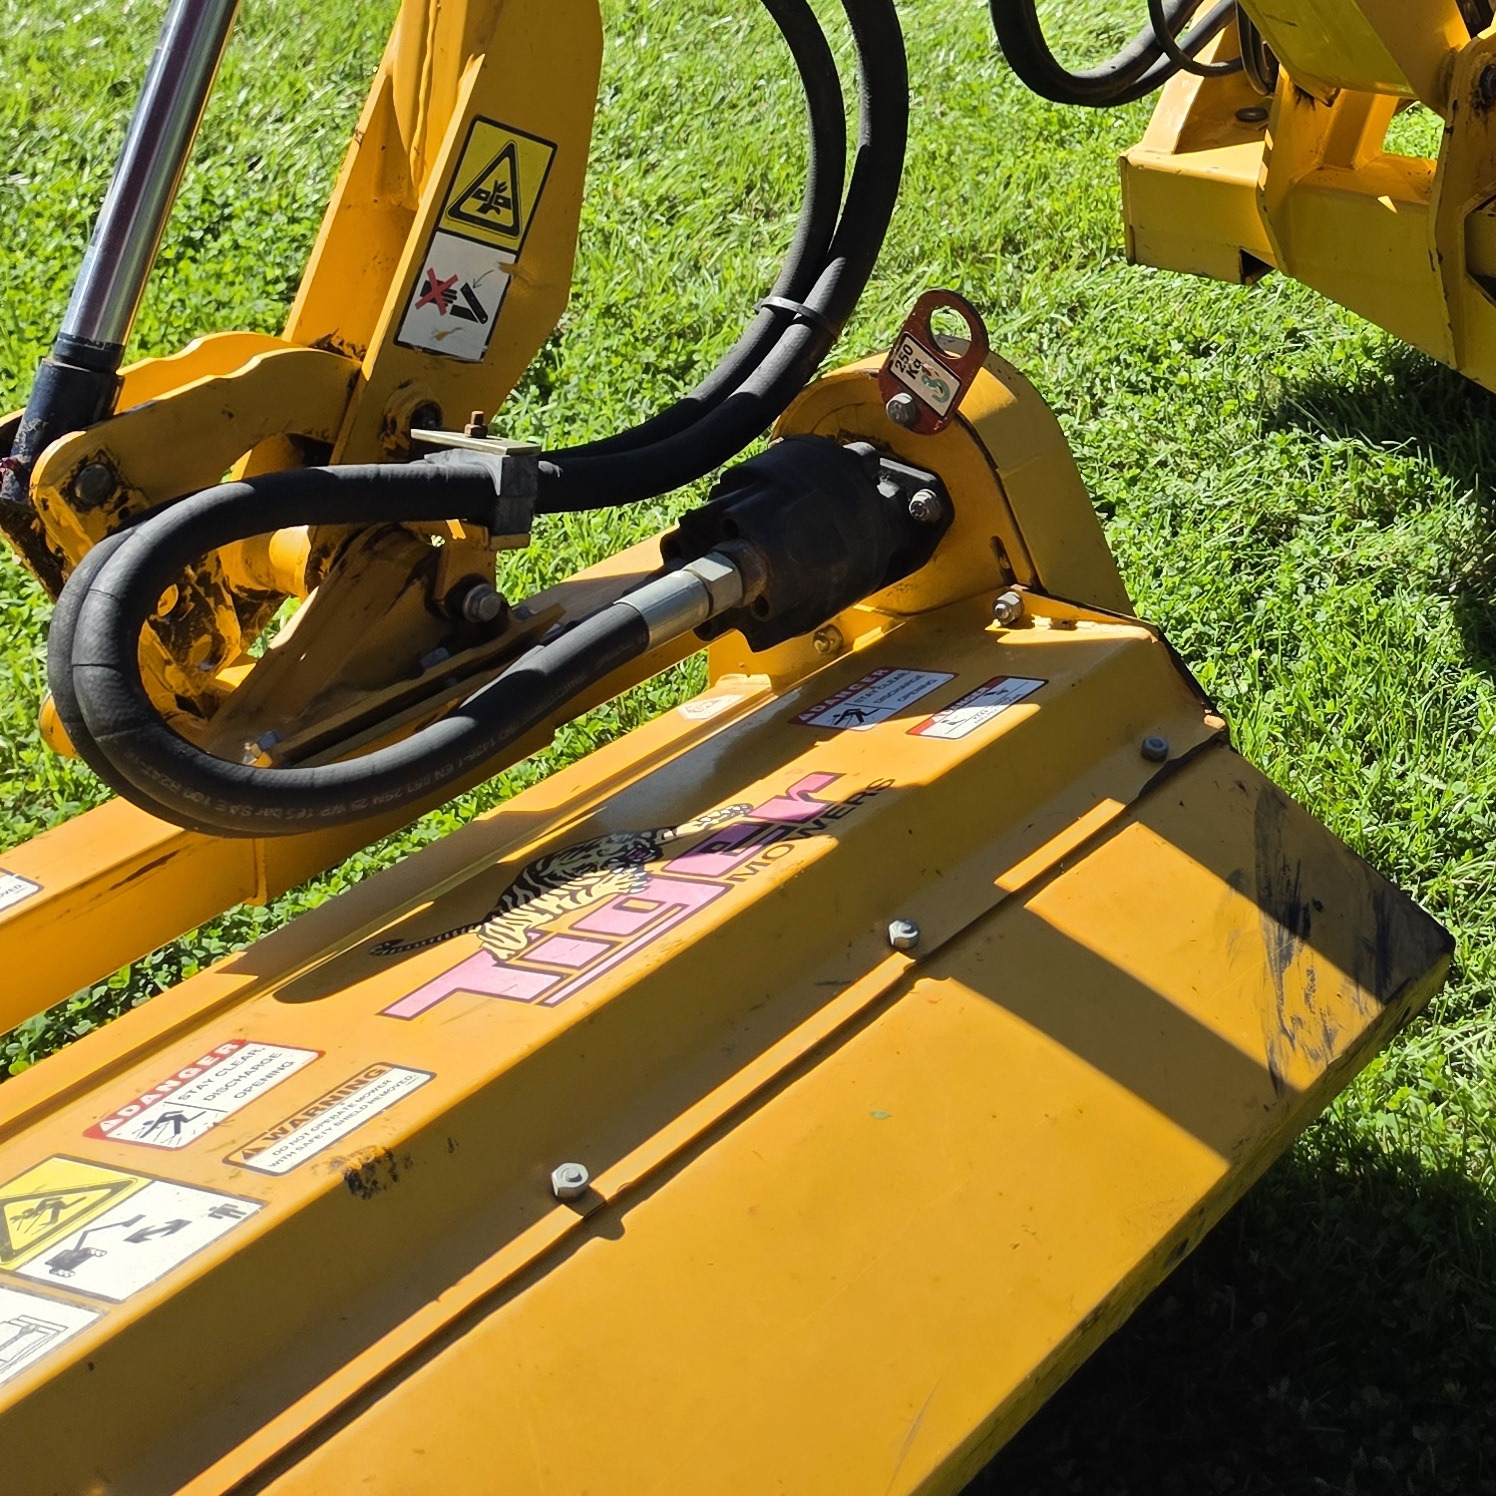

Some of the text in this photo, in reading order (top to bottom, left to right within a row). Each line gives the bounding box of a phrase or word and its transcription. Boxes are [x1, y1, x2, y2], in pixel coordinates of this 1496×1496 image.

[895, 344, 914, 373] 250
[812, 669, 889, 713] DANGER
[215, 799, 254, 818] SAE
[723, 777, 896, 884] MOWERS
[122, 1042, 241, 1118] DANGER
[177, 1078, 215, 1101] STAY
[202, 1051, 283, 1102] DISCHARGE
[233, 1060, 296, 1100] OPENING
[261, 1067, 387, 1142] WARNING
[271, 1079, 393, 1157] DO NOT OPERATE MOWER
[268, 1150, 297, 1169] WITH
[297, 1126, 334, 1152] SAFETY
[333, 1103, 370, 1129] SHIELD
